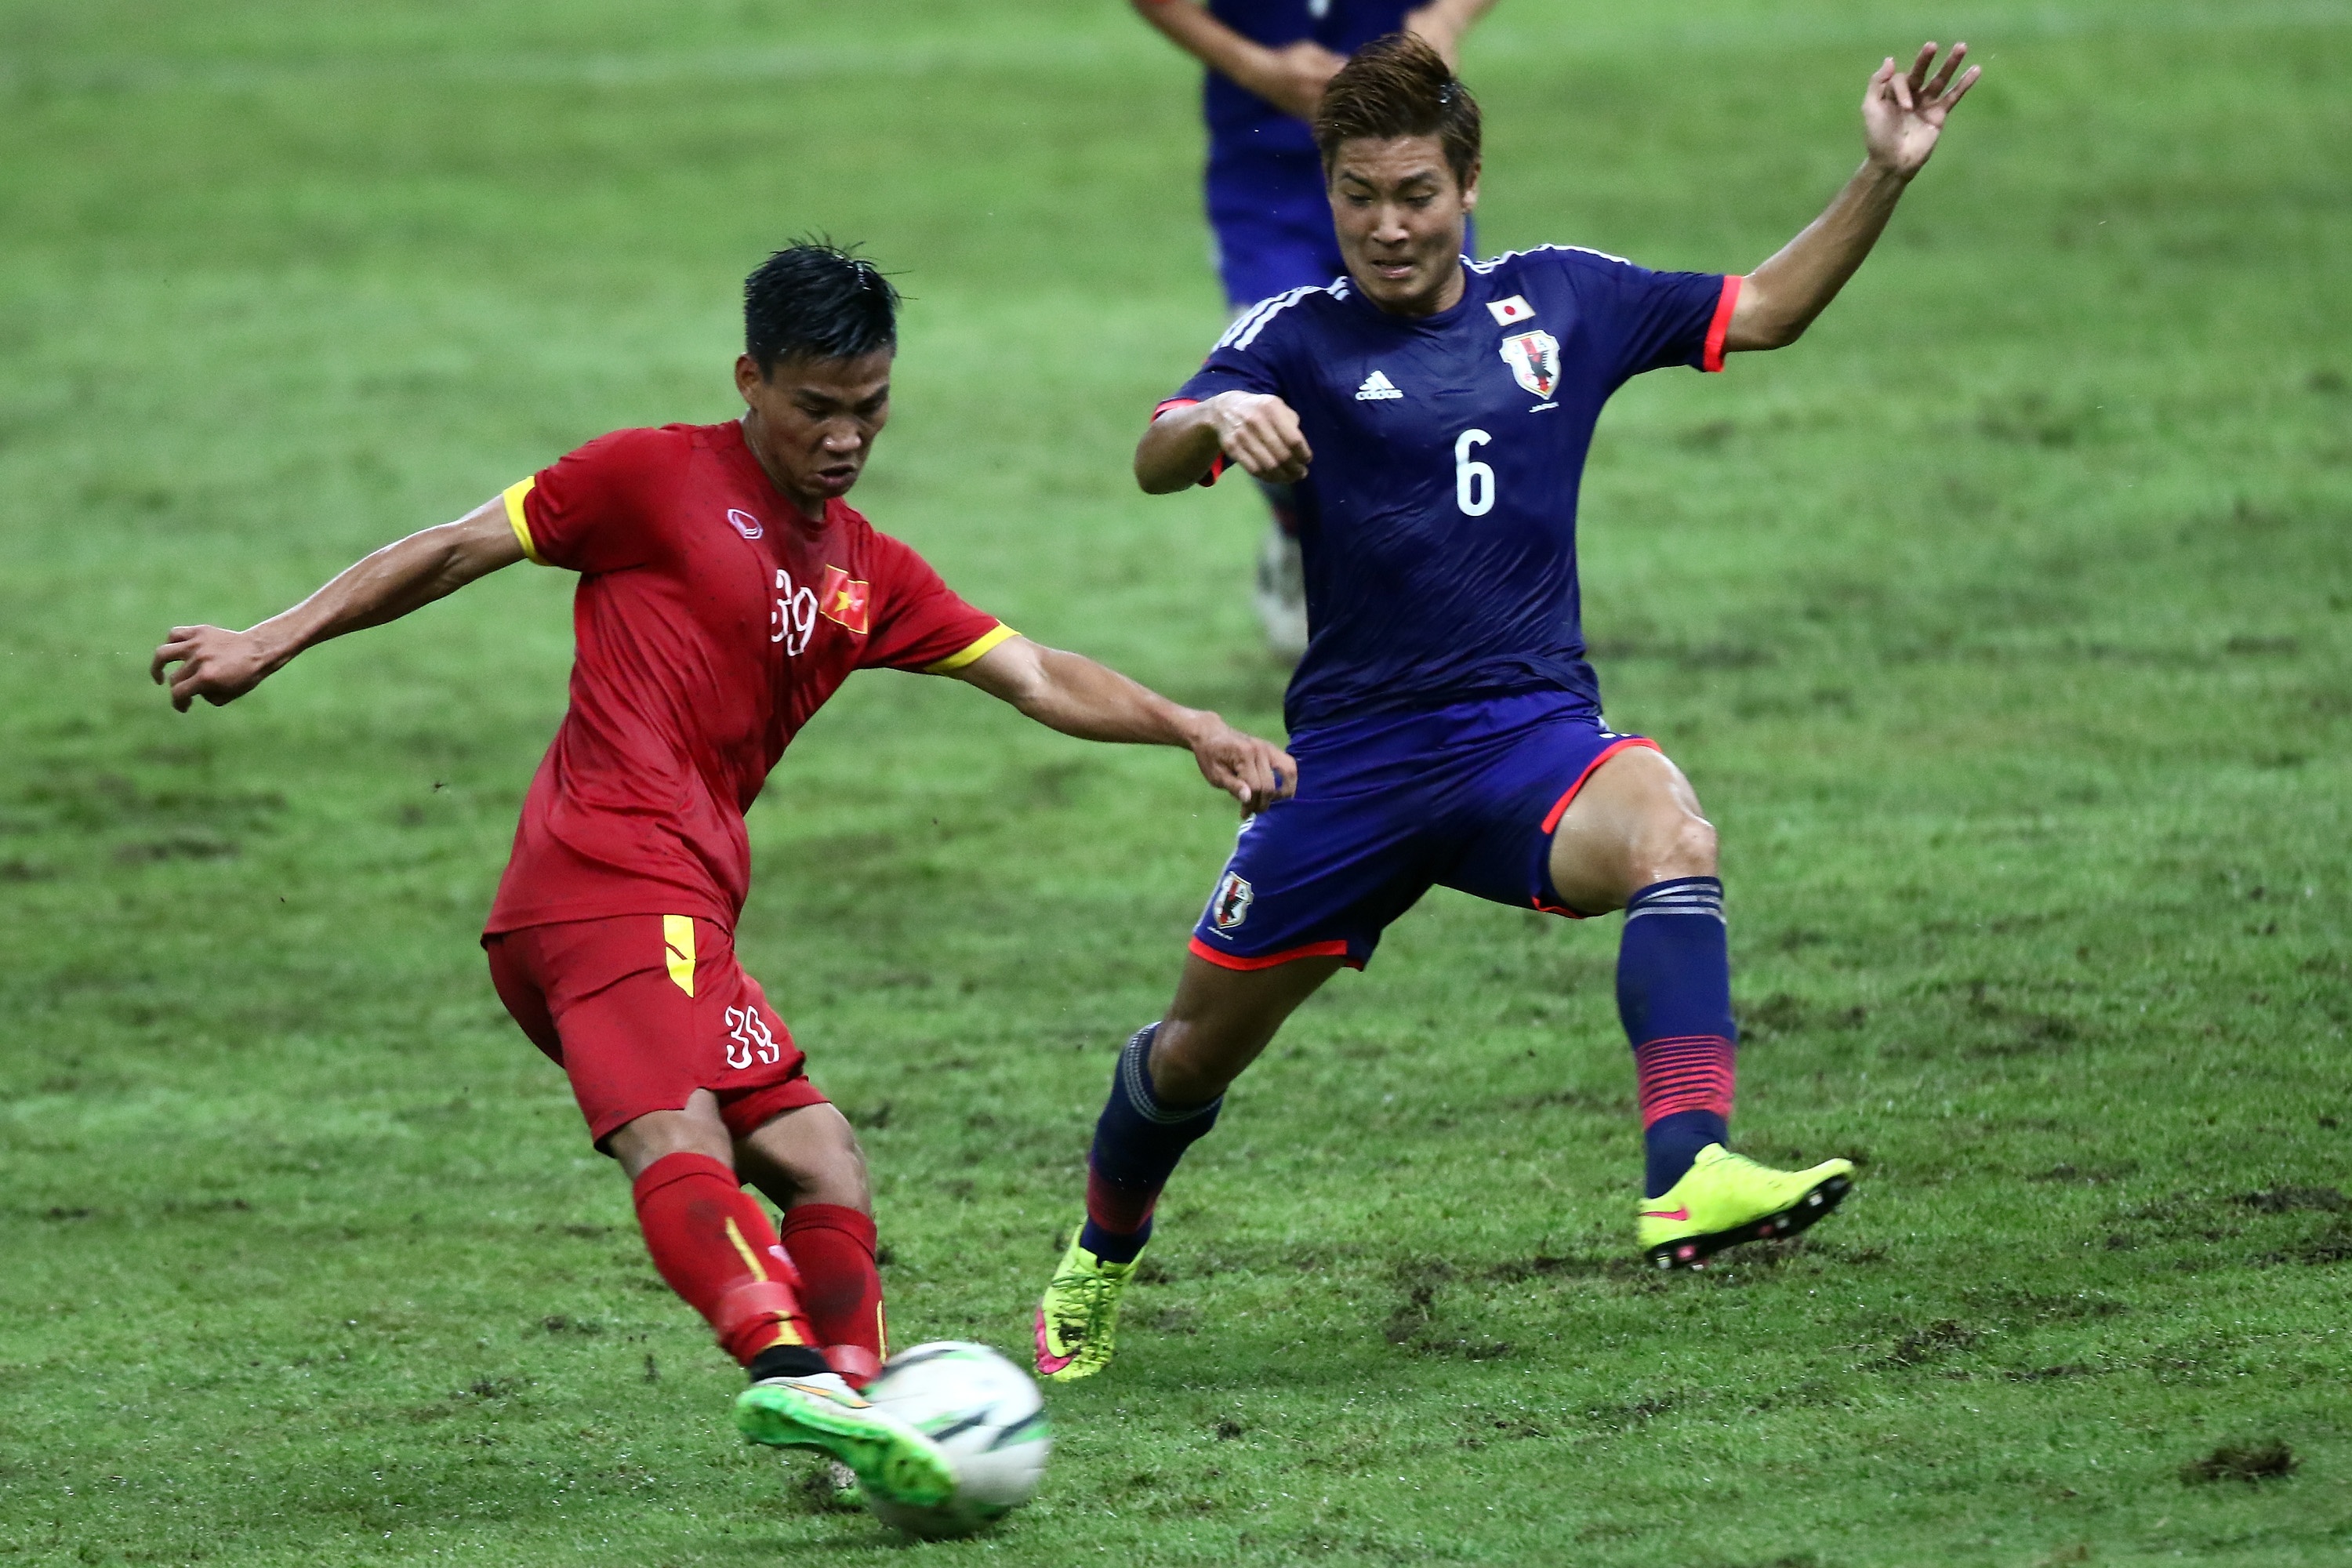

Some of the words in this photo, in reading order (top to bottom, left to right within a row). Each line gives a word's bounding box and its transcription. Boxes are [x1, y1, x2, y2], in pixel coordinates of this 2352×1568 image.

[1355, 389, 1404, 401] adidas
[1454, 428, 1495, 517] 6
[771, 568, 818, 657] 39
[724, 1005, 780, 1069] 39
